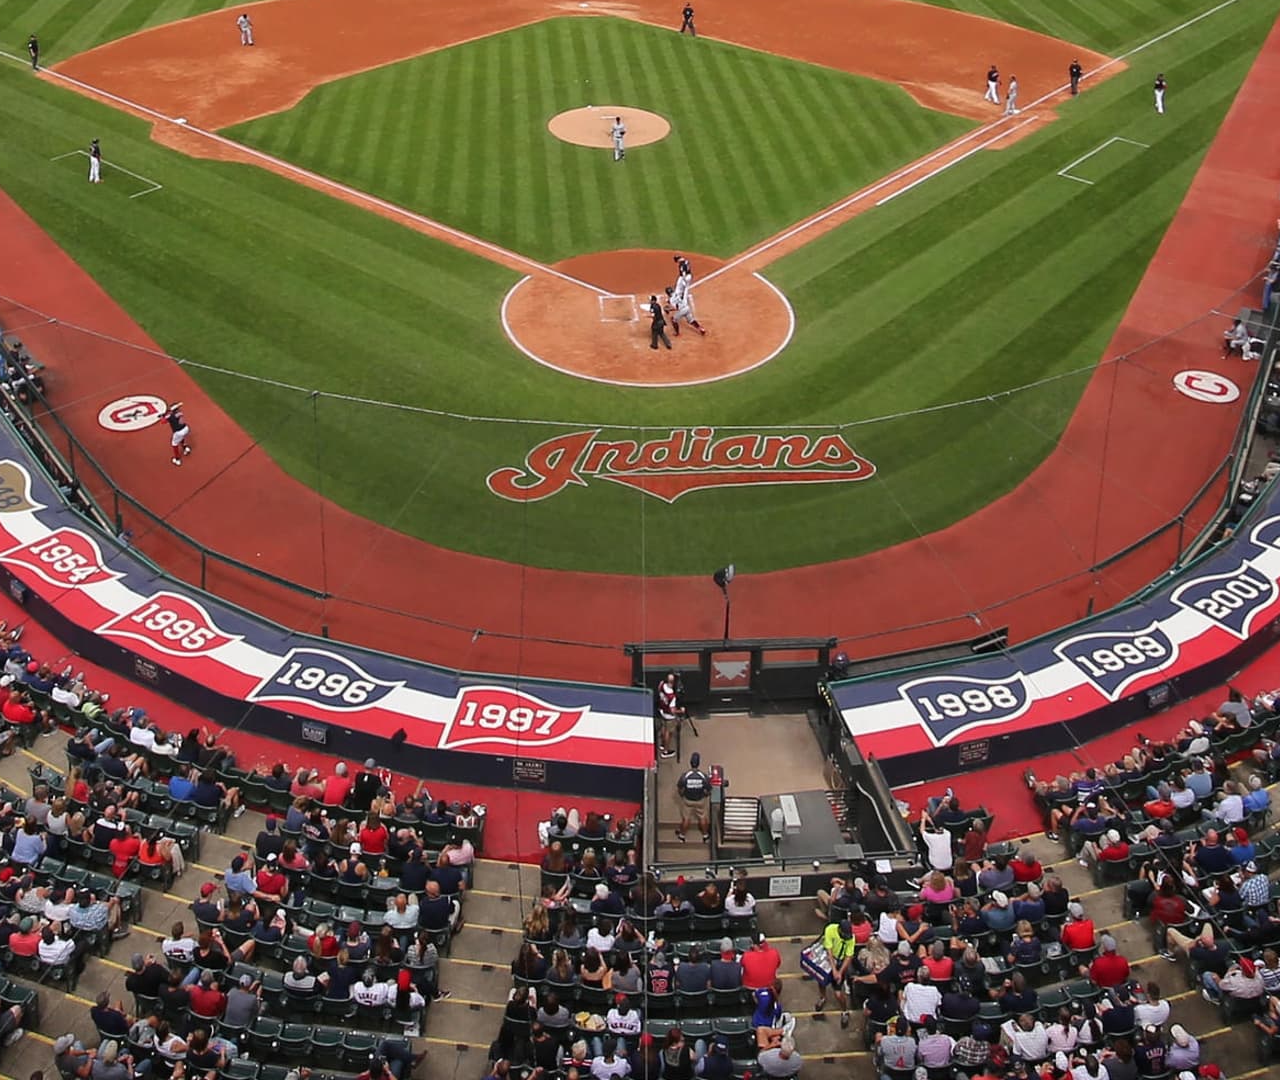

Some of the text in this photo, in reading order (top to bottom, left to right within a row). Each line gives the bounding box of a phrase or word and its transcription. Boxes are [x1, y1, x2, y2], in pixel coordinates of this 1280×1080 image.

[485, 427, 876, 503] Indians
[28, 537, 100, 583] 1954
[1199, 574, 1273, 622] 2001
[131, 602, 217, 651] 1995
[1074, 634, 1166, 679] 1999
[276, 661, 376, 705] 1996
[918, 682, 1019, 722] 1998
[458, 701, 560, 737] 1997
